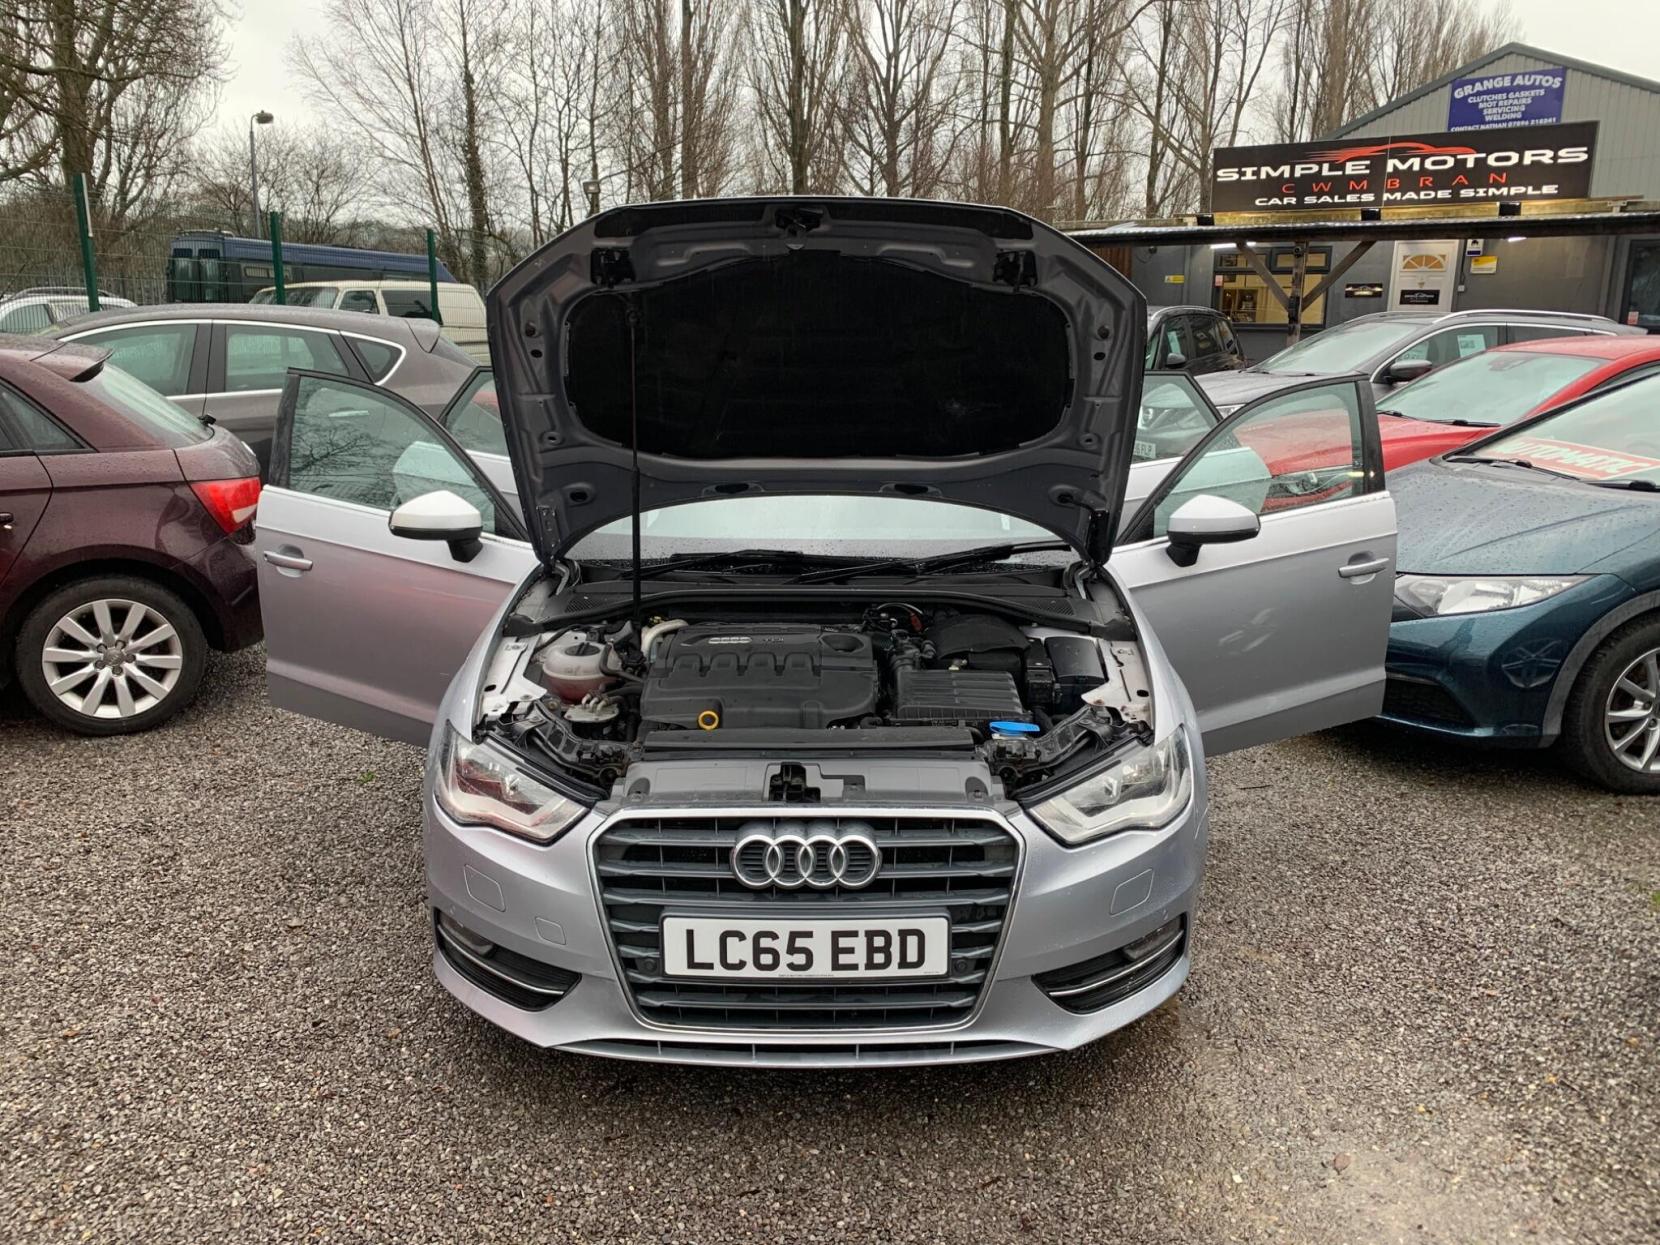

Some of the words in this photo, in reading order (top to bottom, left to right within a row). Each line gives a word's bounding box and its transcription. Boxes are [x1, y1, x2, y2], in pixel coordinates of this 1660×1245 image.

[1454, 76, 1511, 99] GRANGE
[1513, 74, 1562, 88] AUTOS
[1468, 93, 1507, 103] CLUTCHES
[1508, 89, 1545, 99] GASKETS
[1478, 101, 1497, 109] MOT
[1498, 97, 1532, 106] REPAIRS
[1483, 105, 1525, 115] SERVICING
[1484, 112, 1522, 122] WELDING
[1450, 124, 1480, 132] CONTACT
[1480, 121, 1507, 130] NATHAN
[1216, 160, 1371, 182] SIMPLE
[1387, 146, 1588, 173] MOTORS
[1282, 172, 1508, 194] CWMBRAN
[1255, 197, 1297, 206] CAR
[1304, 193, 1375, 204] SALES
[1383, 190, 1452, 201] MADE
[1459, 184, 1559, 198] SIMPLE
[685, 928, 814, 972] LC65
[830, 928, 926, 971] EBD
